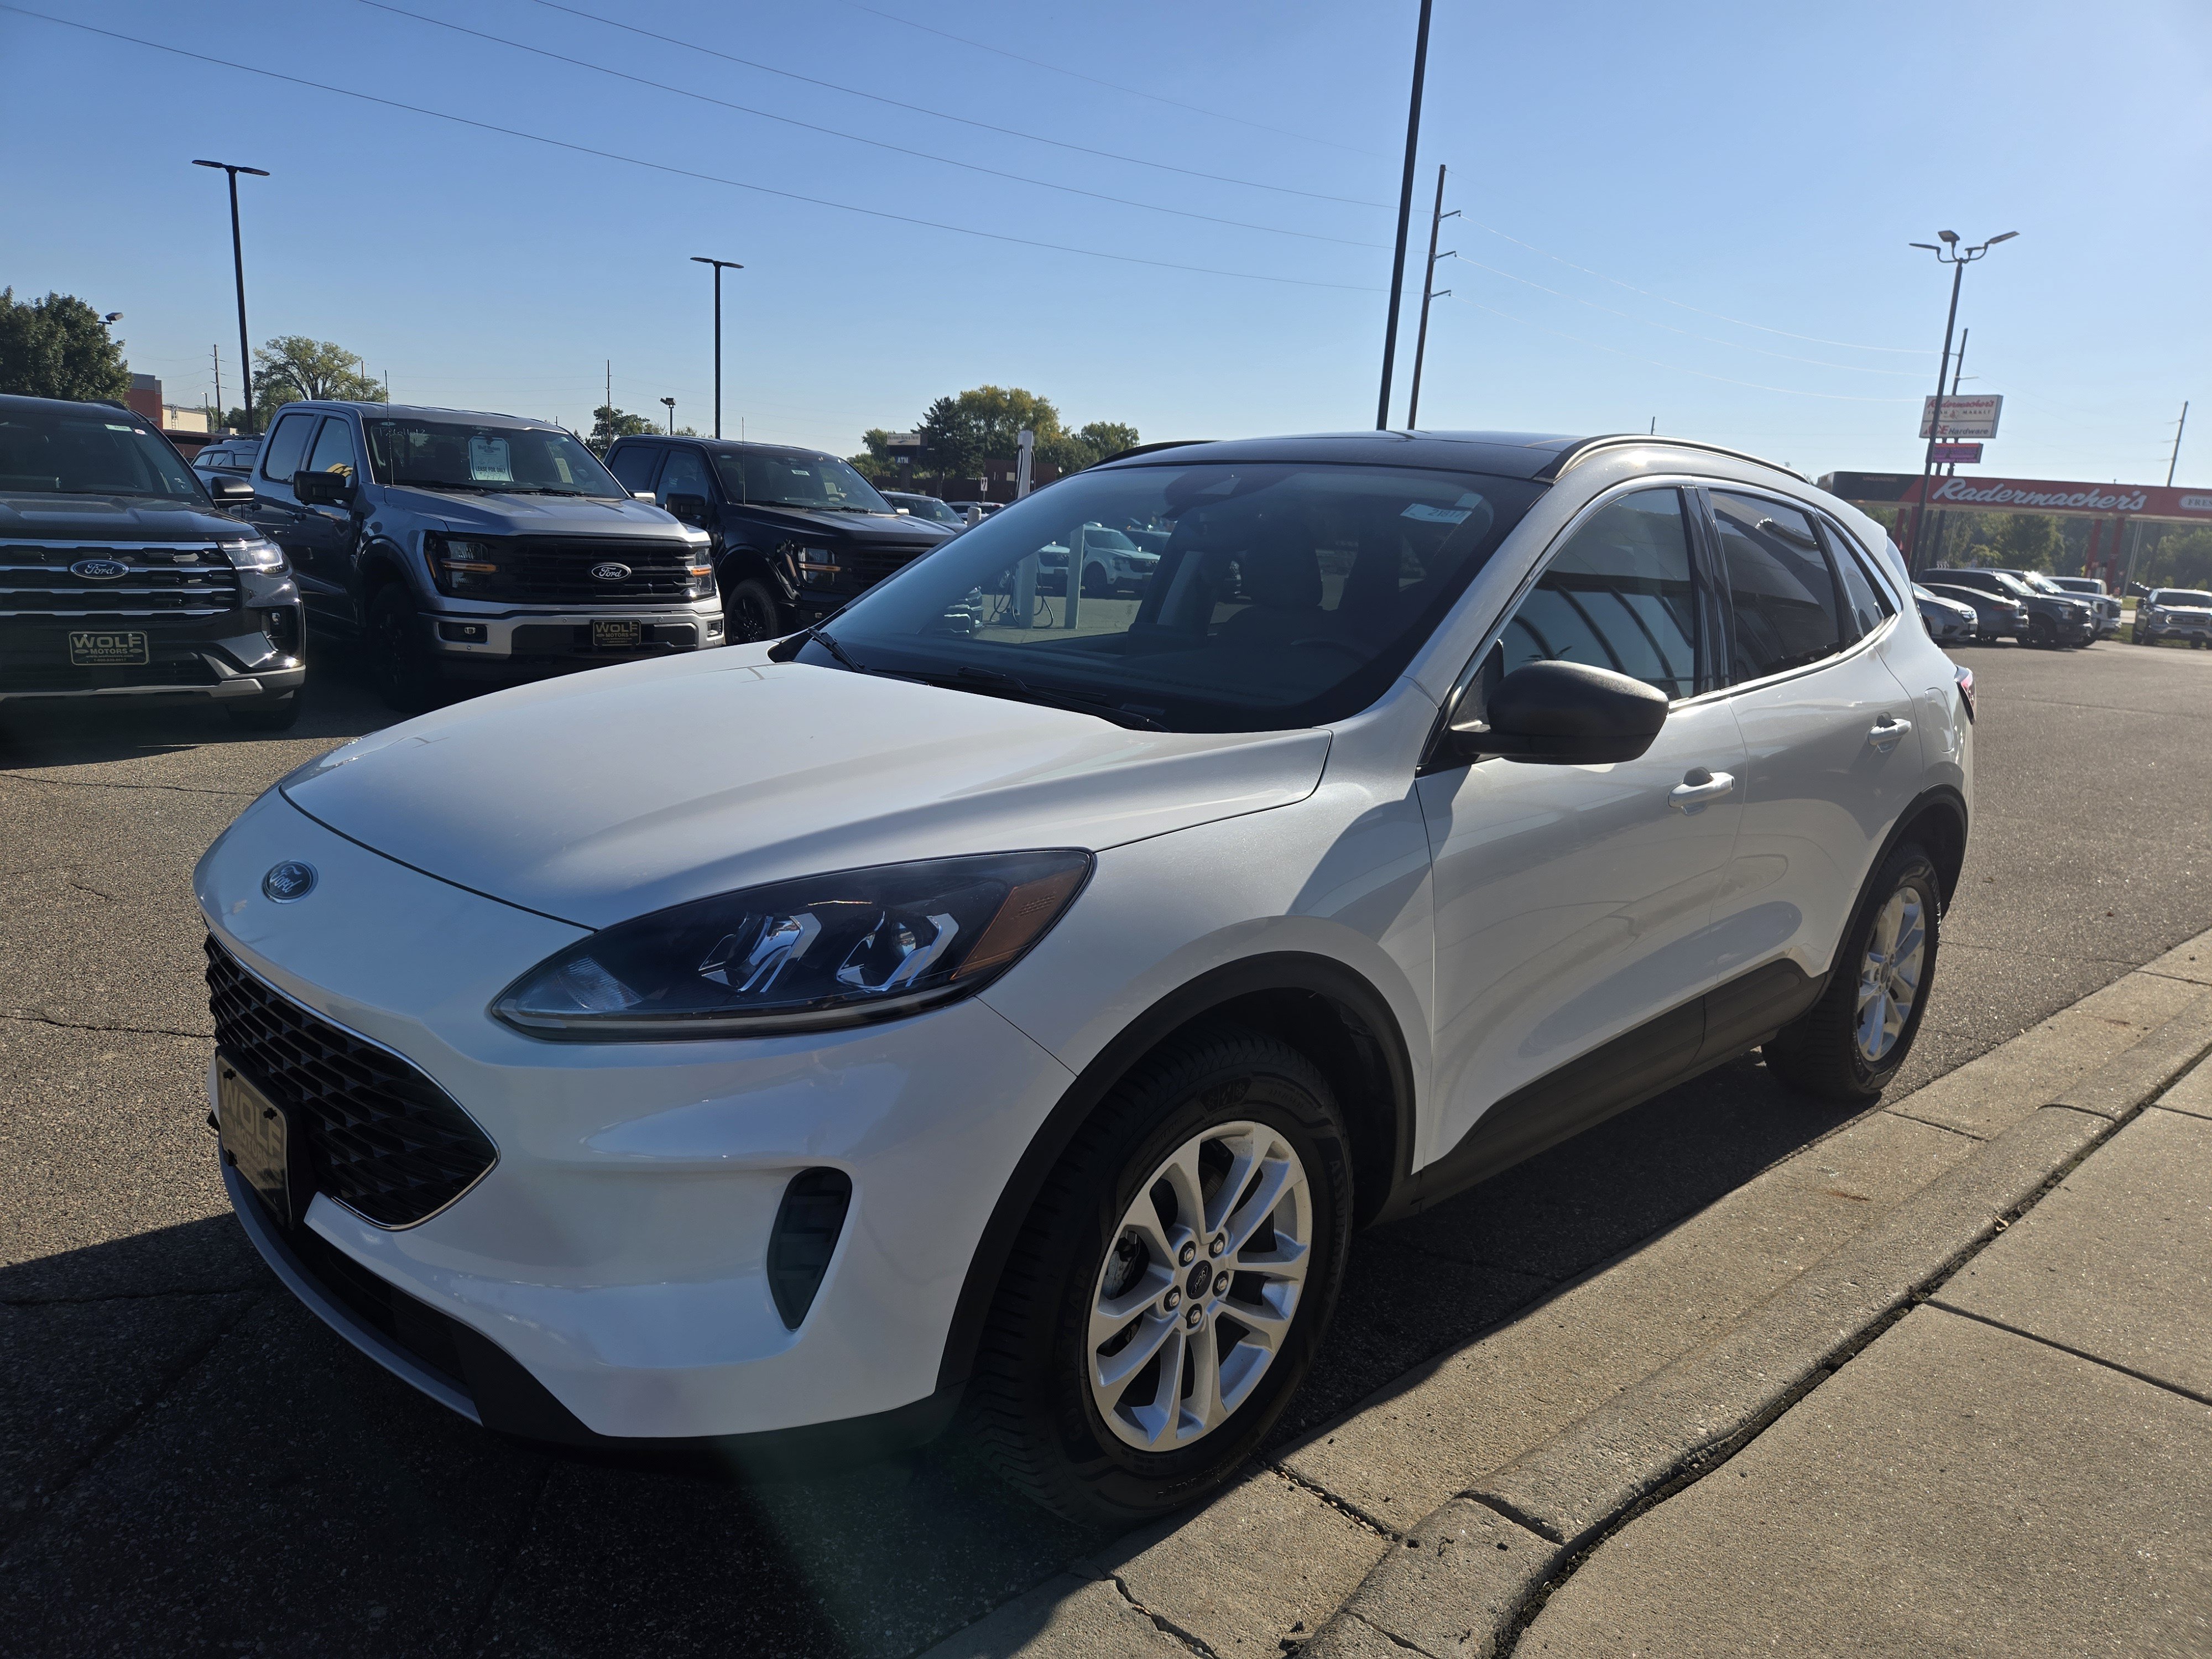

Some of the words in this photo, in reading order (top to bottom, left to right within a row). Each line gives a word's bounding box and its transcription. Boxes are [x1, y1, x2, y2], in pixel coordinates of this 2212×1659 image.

[1927, 398, 1994, 409] Rdermacher's
[1932, 478, 2147, 510] Radermacher's
[85, 563, 114, 575] Ford
[598, 566, 622, 577] Ford
[595, 624, 638, 633] WOLF
[72, 637, 142, 648] WOLF
[269, 865, 302, 893] Ford
[220, 1071, 281, 1155] WOLF
[234, 1120, 268, 1167] MOTORS
[1194, 1270, 1206, 1292] Ford
